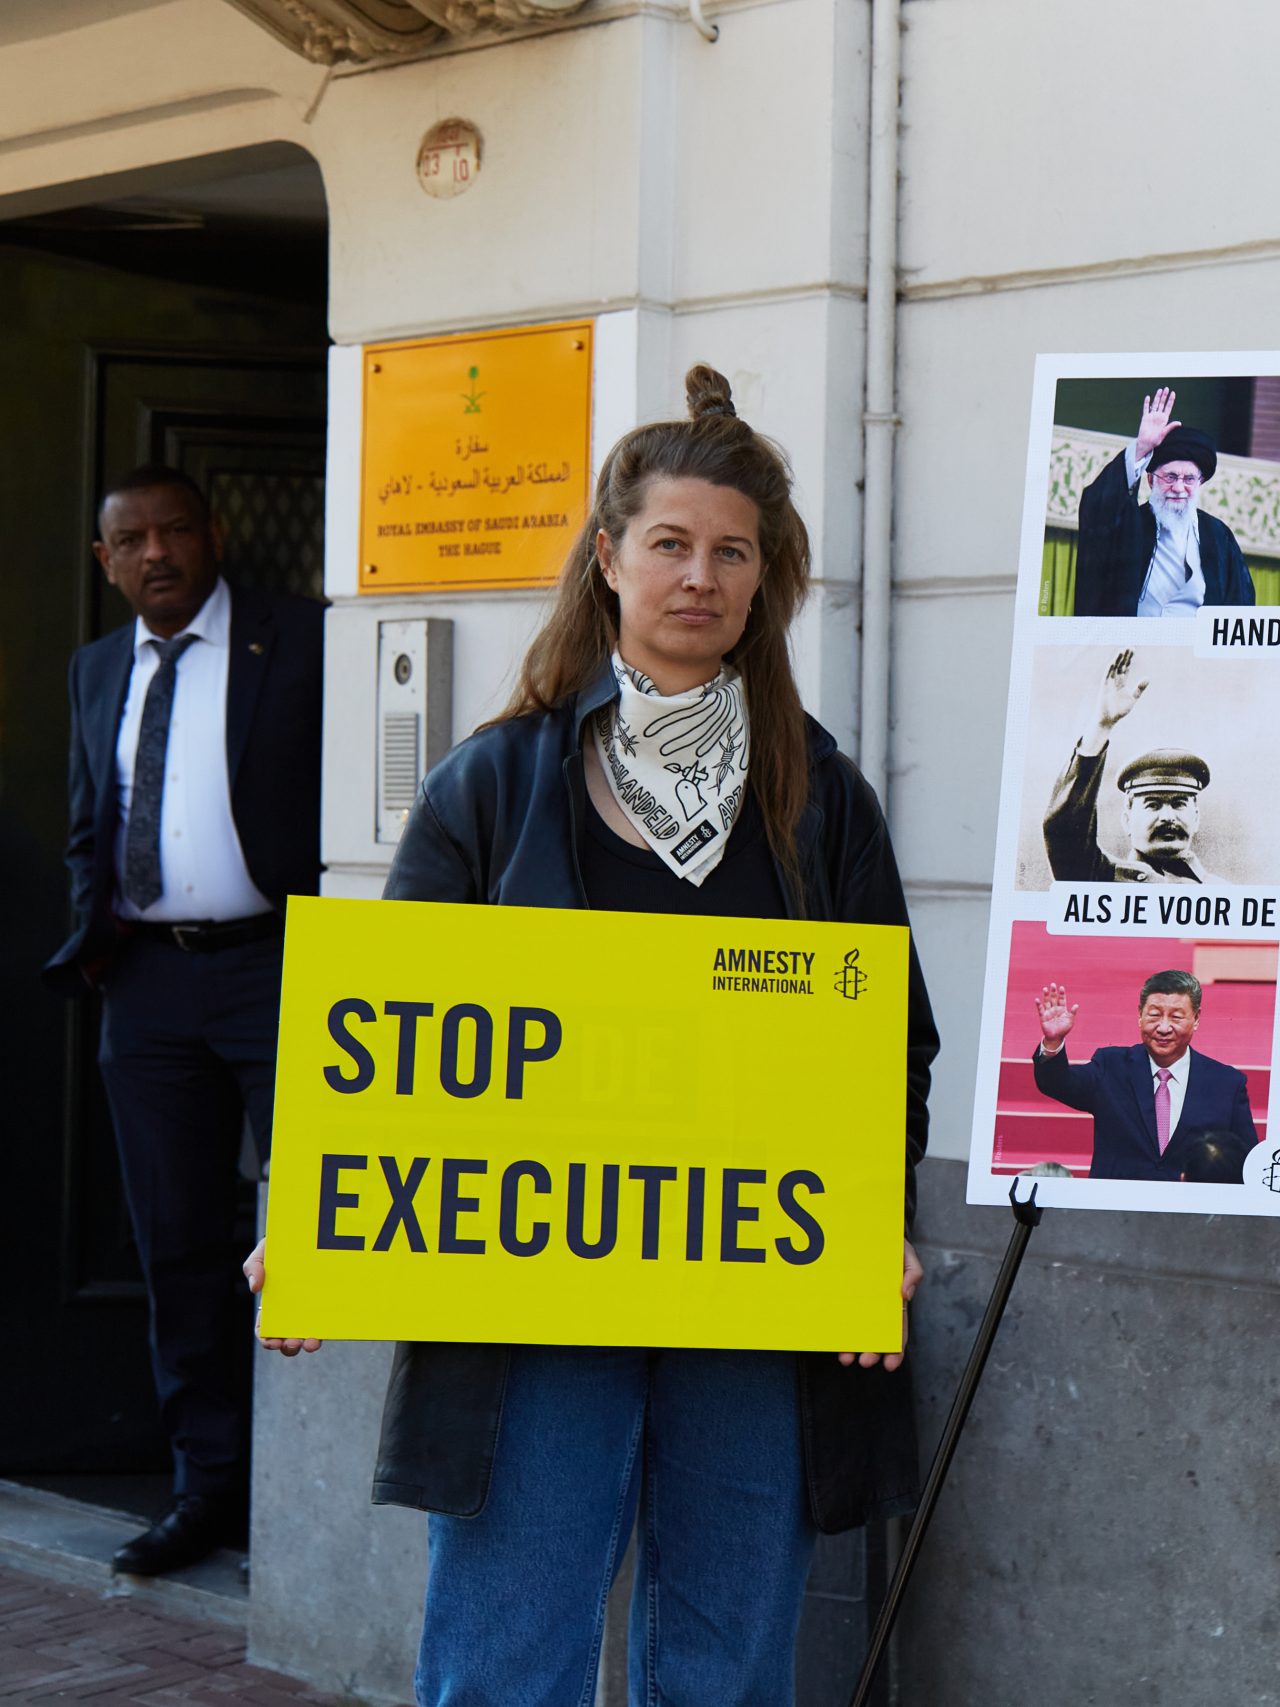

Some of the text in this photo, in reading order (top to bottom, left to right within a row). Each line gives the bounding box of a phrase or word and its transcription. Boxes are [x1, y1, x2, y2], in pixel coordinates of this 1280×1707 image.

[456, 435, 489, 461] سفارة
[429, 468, 480, 497] السعودية
[484, 464, 525, 494] العربية
[526, 462, 571, 484] المملكة
[378, 475, 413, 505] لاهاي
[377, 513, 569, 537] ROYAL EMBASSY OF SAUDI ARABIA
[438, 542, 502, 557] THE HAGUE
[676, 834, 700, 857] AMNESTY
[1064, 894, 1112, 924] ALS
[1120, 895, 1148, 924] JE
[1158, 896, 1231, 926] VOOR
[1241, 897, 1277, 927] DE
[713, 948, 816, 976] AMNESTY
[712, 975, 814, 995] INTERNATIONAL
[323, 997, 563, 1100] STOP
[316, 1153, 825, 1266] EXECUTIES
